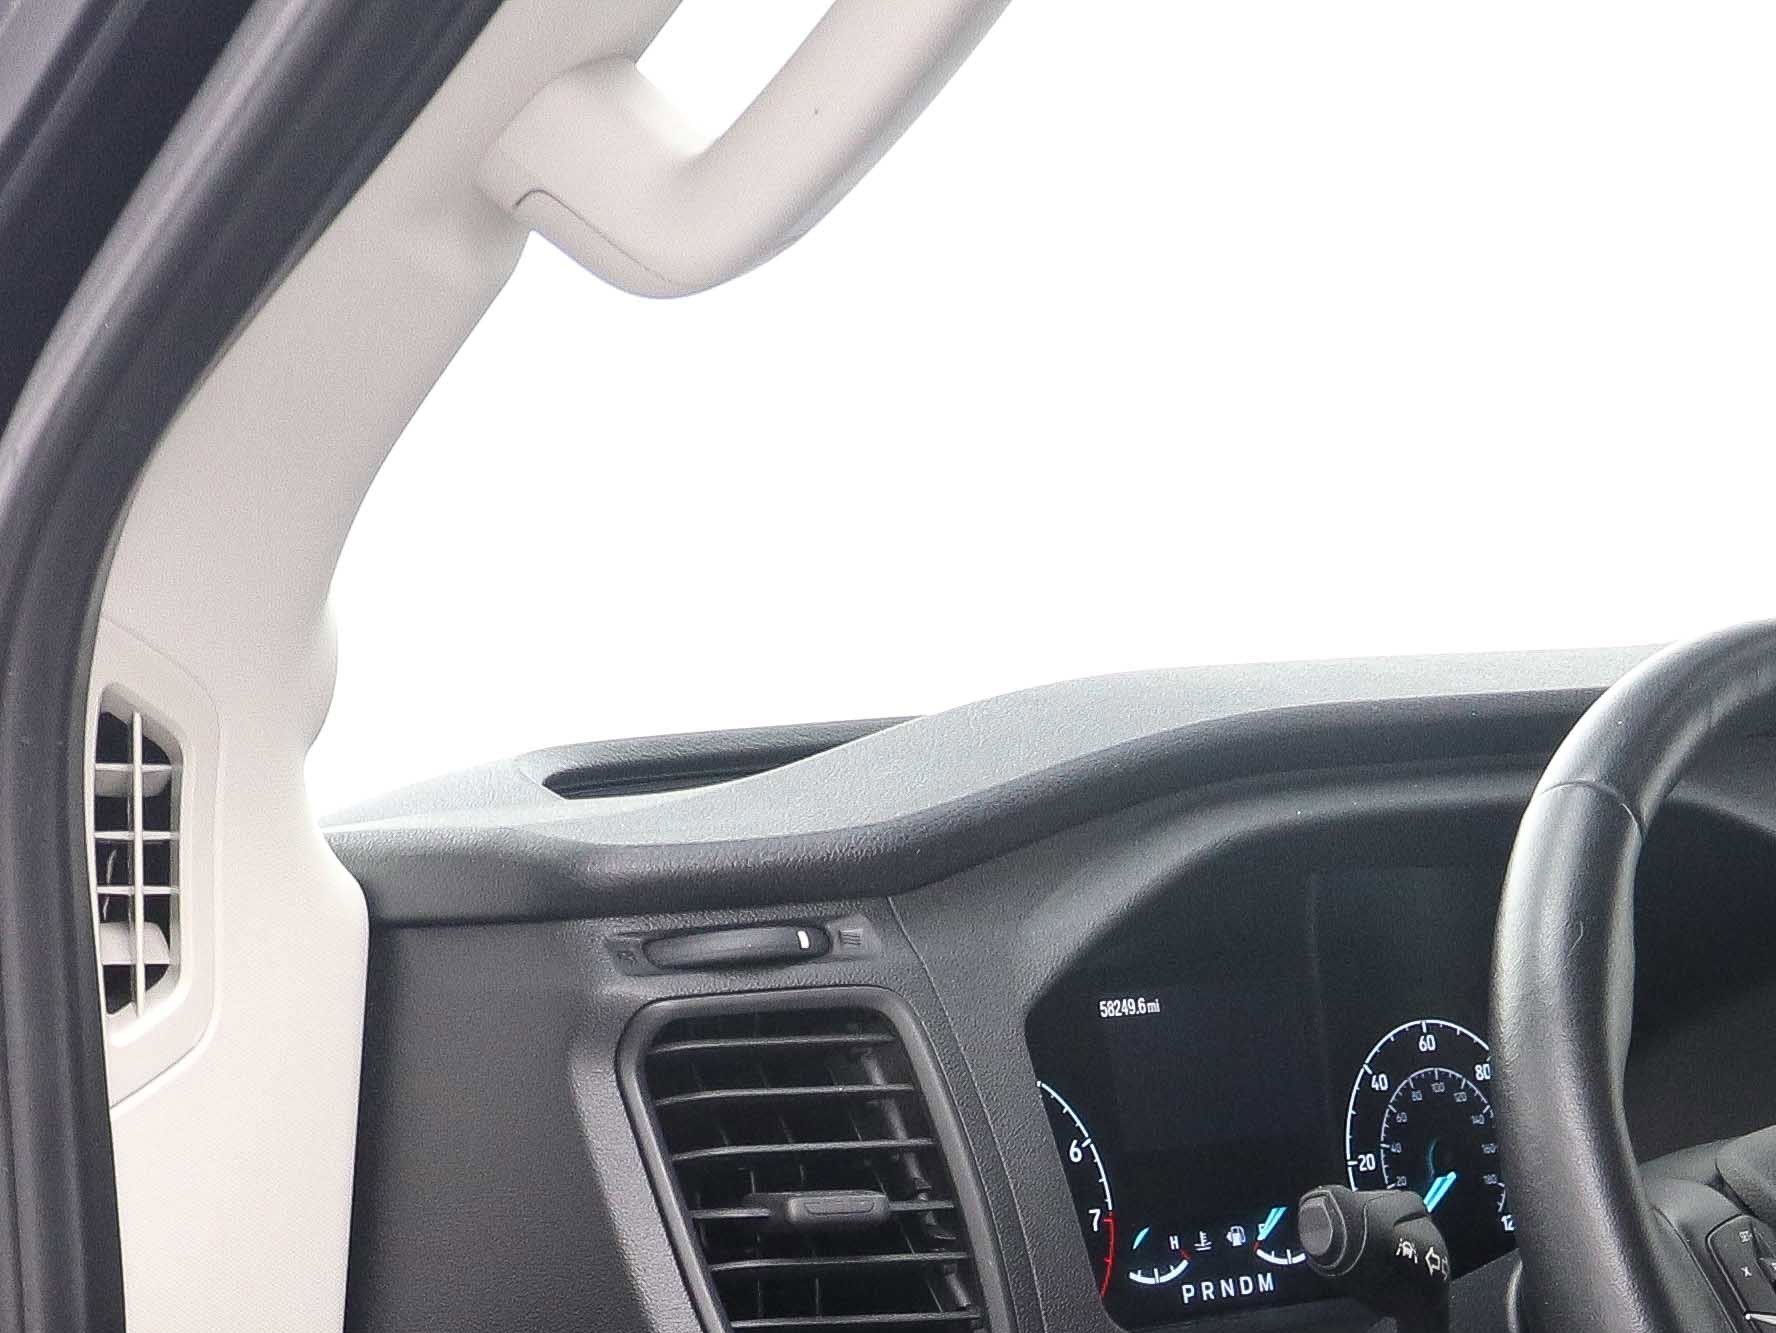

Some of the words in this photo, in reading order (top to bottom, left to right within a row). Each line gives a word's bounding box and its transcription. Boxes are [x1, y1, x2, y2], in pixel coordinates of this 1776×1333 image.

[1418, 1035, 1436, 1051] 60
[1474, 1063, 1491, 1080] 80
[1371, 1073, 1389, 1091] 40
[1396, 1112, 1408, 1123] 60
[1069, 1139, 1083, 1163] 6
[1357, 1154, 1376, 1172] 20
[1395, 1176, 1407, 1187] 20
[1088, 1208, 1101, 1232] 7
[1500, 1214, 1516, 1232] 12
[1168, 1235, 1180, 1250] H
